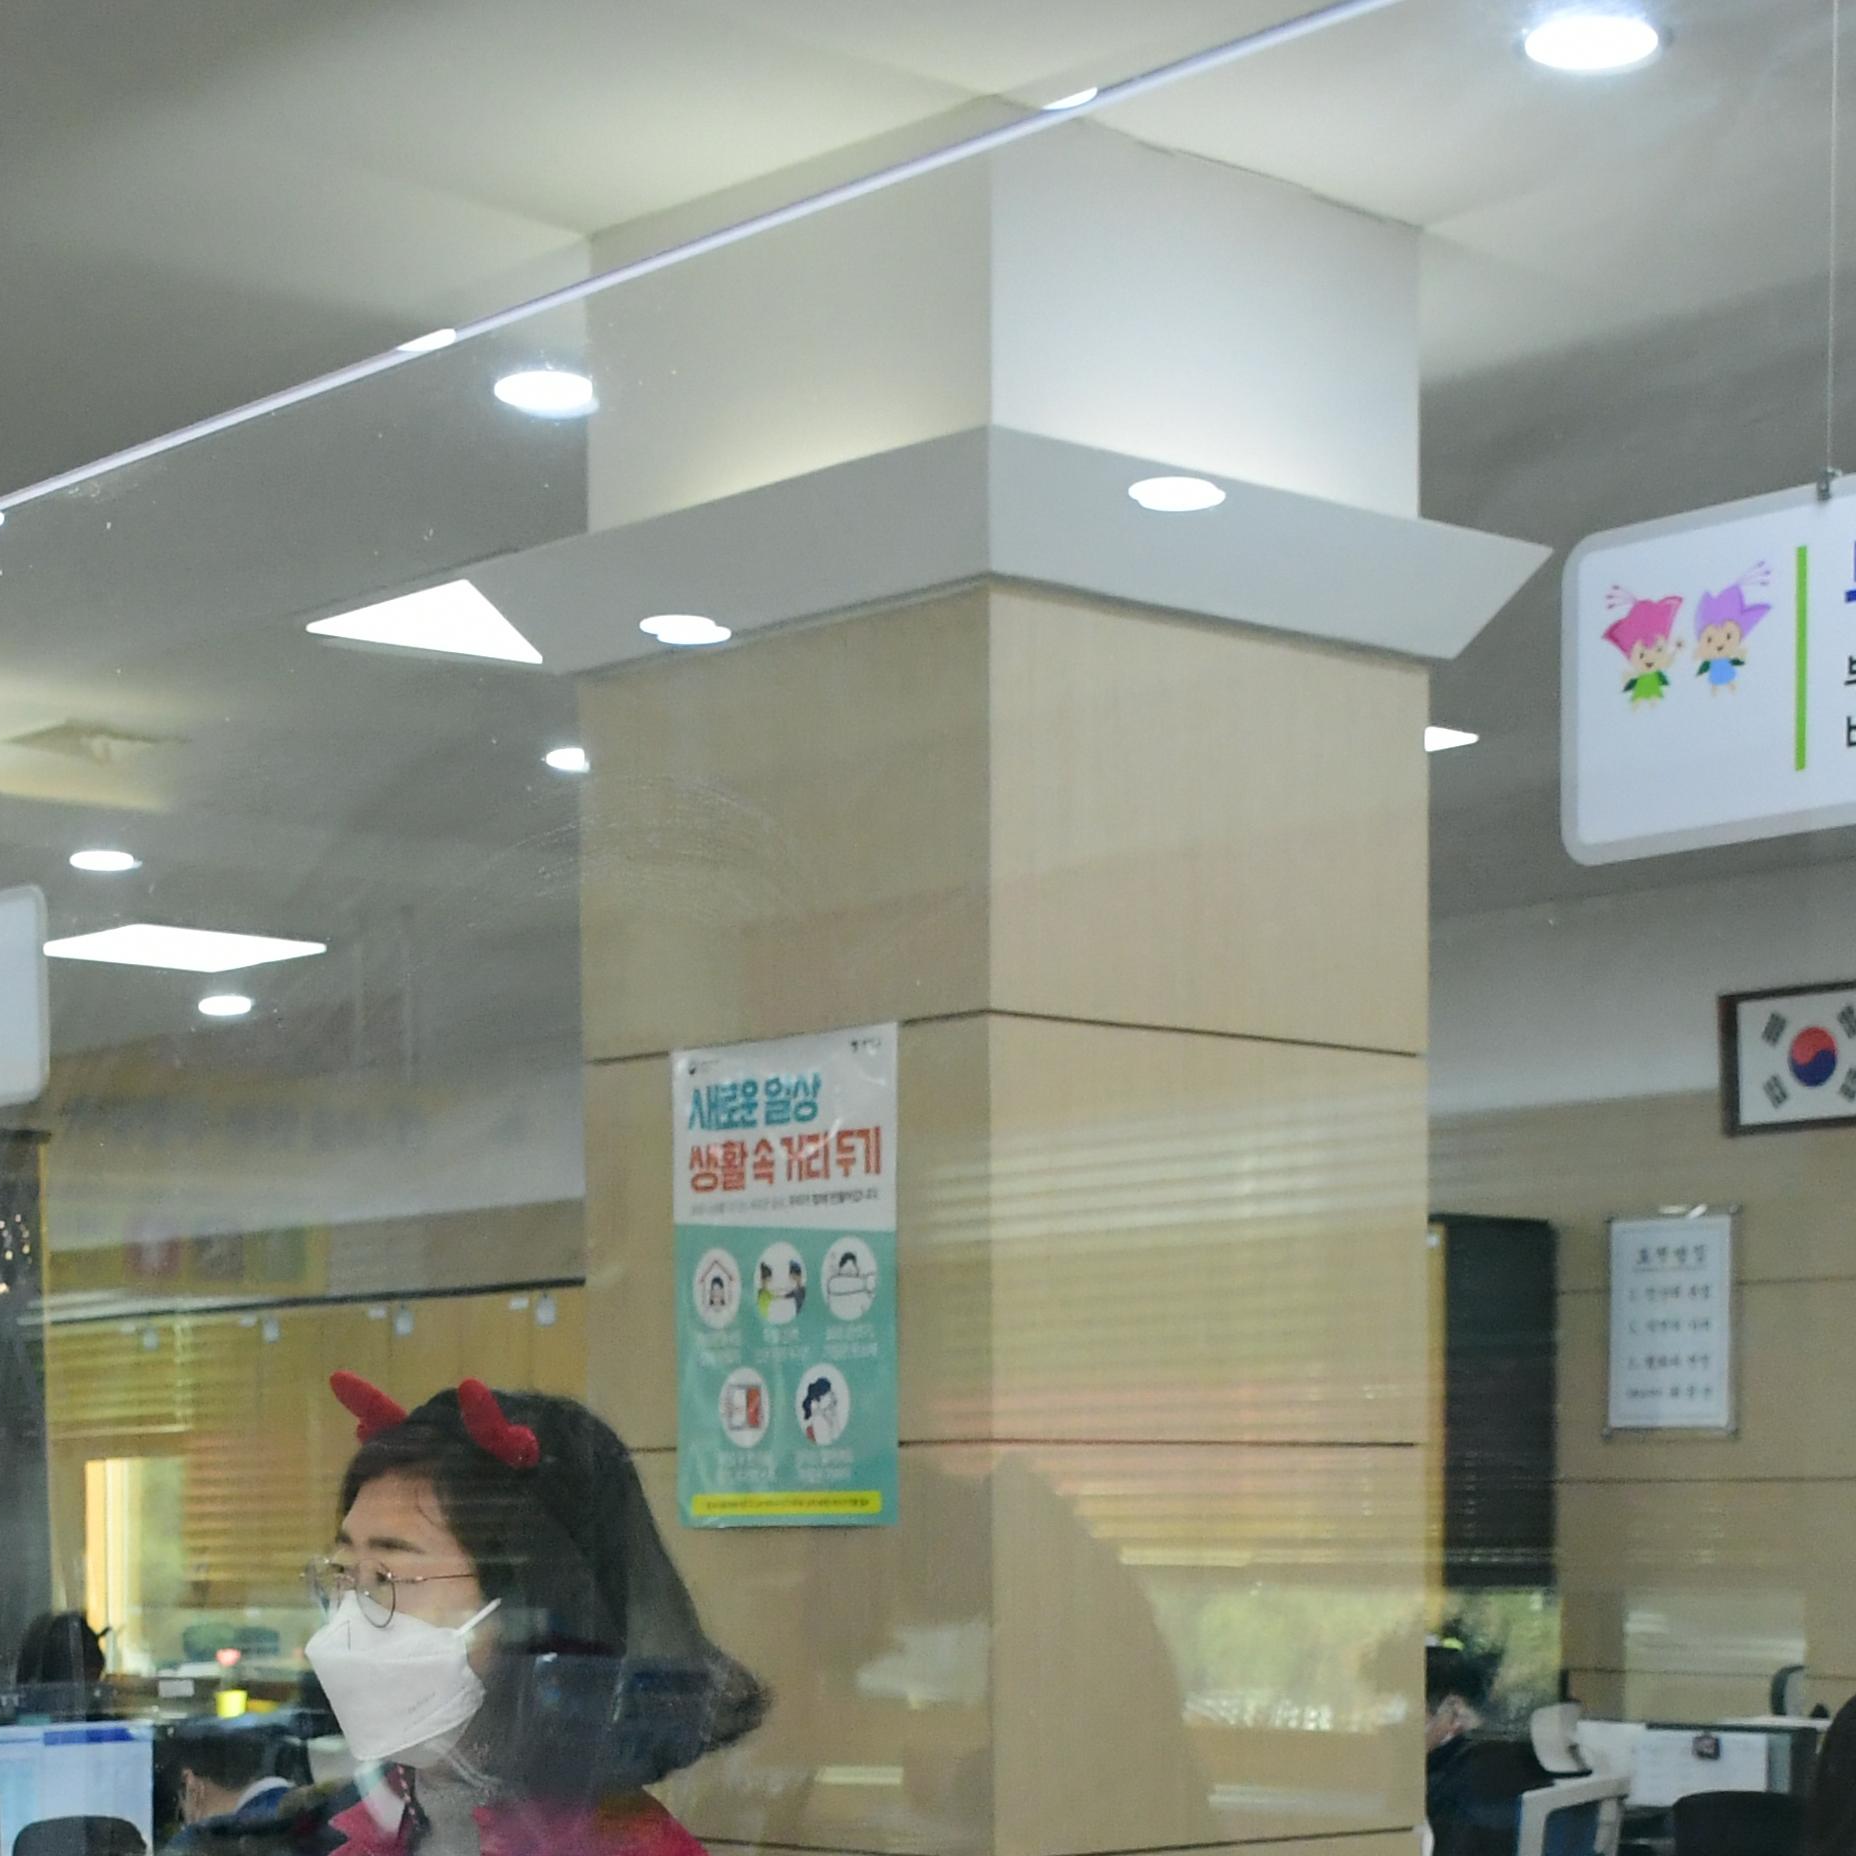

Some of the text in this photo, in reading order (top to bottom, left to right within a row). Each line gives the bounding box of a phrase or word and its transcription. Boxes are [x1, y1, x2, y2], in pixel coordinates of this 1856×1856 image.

[764, 1072, 822, 1125] 일상
[689, 1140, 748, 1193] 생활
[753, 1139, 774, 1185] 속
